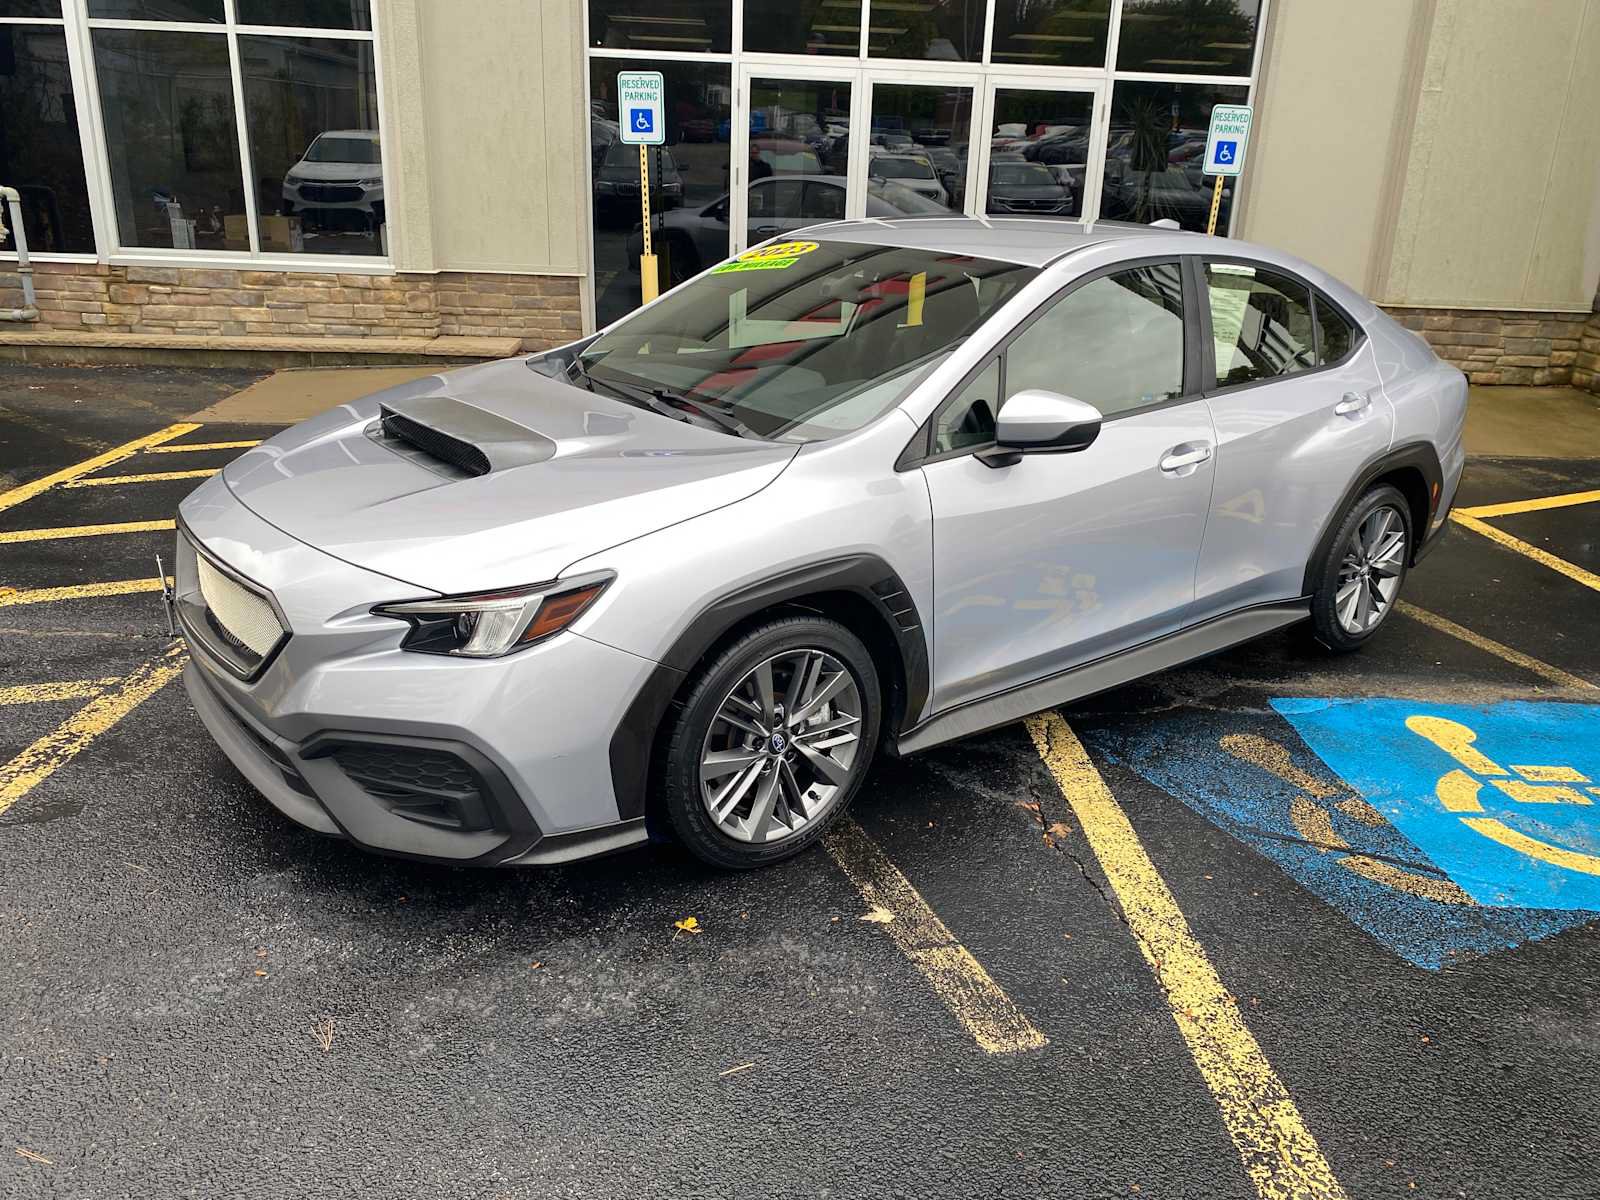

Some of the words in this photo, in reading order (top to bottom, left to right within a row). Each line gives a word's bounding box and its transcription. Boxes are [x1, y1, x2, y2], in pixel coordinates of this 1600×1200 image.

[622, 80, 659, 89] RESERVED
[625, 92, 658, 101] PARKING
[1215, 112, 1248, 123] RESERVED
[1215, 125, 1244, 134] PARKING
